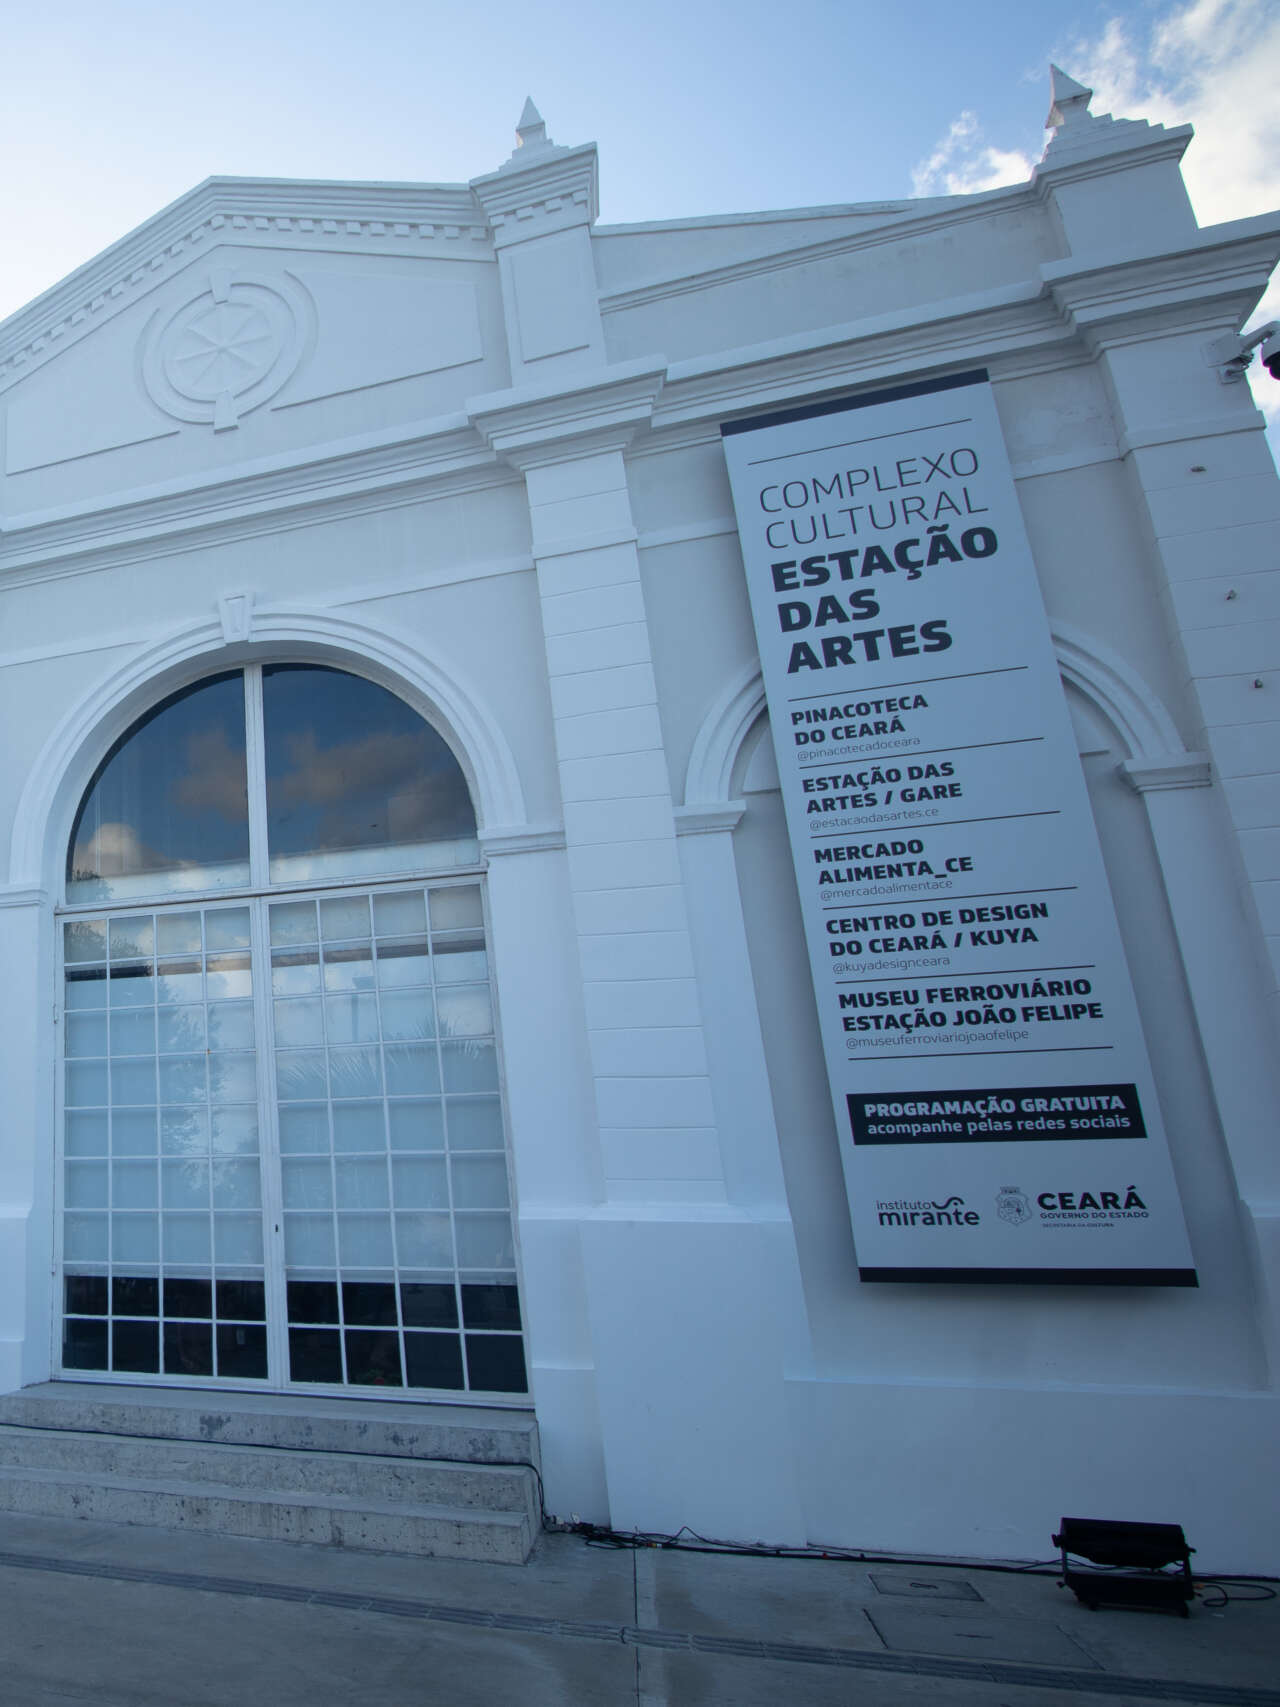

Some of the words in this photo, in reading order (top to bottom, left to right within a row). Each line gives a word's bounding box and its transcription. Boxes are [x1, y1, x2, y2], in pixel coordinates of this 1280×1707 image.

[760, 448, 979, 513] COMPLEXO
[766, 487, 988, 549] CULTURAL
[770, 524, 999, 592] ESTAÇÃO
[777, 588, 880, 632] DAS
[787, 620, 953, 674] ARTES
[791, 694, 928, 726] PINACOTECA
[795, 728, 825, 746] DO
[832, 715, 906, 741] CEARÁ
[797, 736, 921, 762] @pinacotecadoceara
[802, 766, 902, 793] ESTAÇÃO
[907, 762, 954, 781] DAS
[806, 792, 878, 814] ARTES
[884, 790, 893, 805] /
[900, 782, 963, 803] GARE
[810, 806, 939, 831] @estacaodasartes.ce
[814, 839, 924, 864] MERCADO
[818, 856, 974, 885] ALIMENTA_CE
[820, 878, 953, 901] @mercadoalimentace
[826, 913, 916, 935] CENTRO
[922, 910, 953, 928] DE
[959, 902, 1049, 925] DESIGN
[829, 940, 863, 957] DO
[868, 930, 947, 953] CEARÁ
[954, 932, 963, 948] /
[970, 927, 1039, 947] KUYA
[832, 956, 951, 975] @kuyadesignceara
[838, 989, 920, 1010] MUSEU
[926, 978, 1092, 1005] FERROVIÁRIO
[842, 1009, 947, 1033] ESTAÇÃO
[952, 1005, 1017, 1027] JOÃO
[1022, 1002, 1104, 1023] FELIPE
[845, 1028, 1029, 1050] @museuferroviariojoaofelipe
[864, 1096, 1016, 1118] PROGRAMAÇÃO
[1021, 1095, 1126, 1113] GRATUITA
[867, 1118, 963, 1137] acompanhe
[967, 1117, 1013, 1135] pelas
[1017, 1115, 1066, 1131] redes
[1070, 1114, 1131, 1129] sociais
[877, 1199, 932, 1211] instituto
[1037, 1185, 1146, 1211] CEARÁ
[879, 1206, 980, 1227] mirante
[1040, 1211, 1089, 1220] GOVERNO
[1091, 1211, 1107, 1219] DO
[1108, 1210, 1149, 1219] ESTADO
